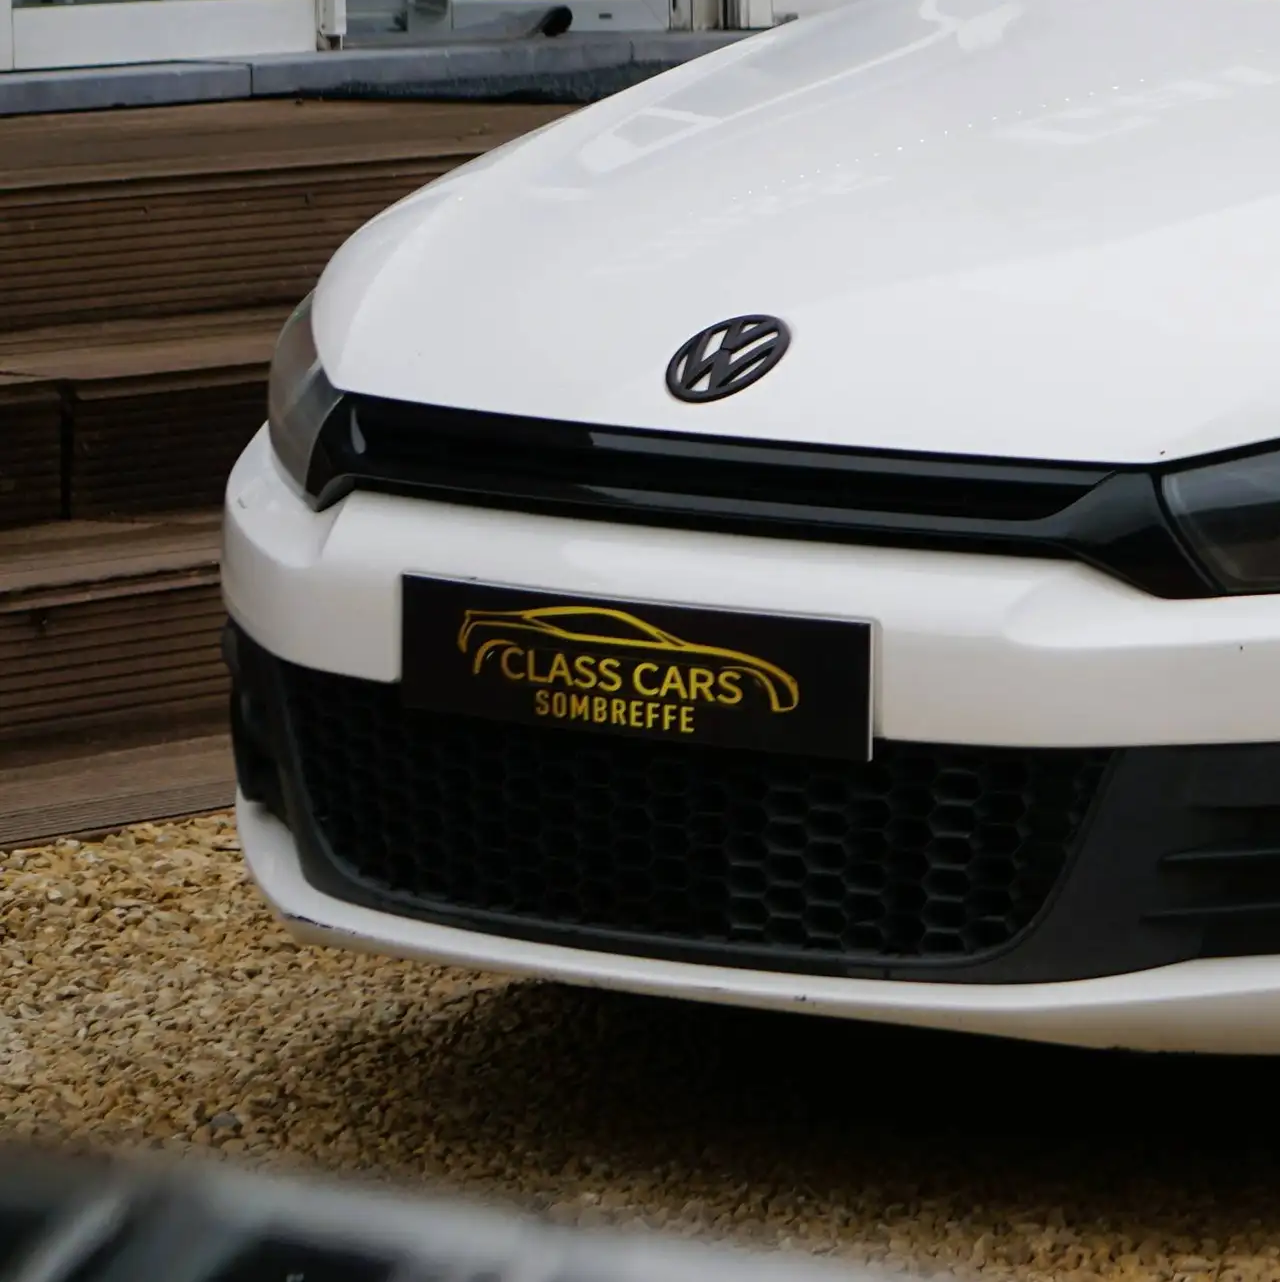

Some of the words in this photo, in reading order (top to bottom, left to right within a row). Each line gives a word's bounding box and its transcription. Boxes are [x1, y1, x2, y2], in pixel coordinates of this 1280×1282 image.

[501, 647, 622, 692] CLASS
[632, 662, 744, 705] CARS
[535, 689, 695, 733] SOMBREFFE
